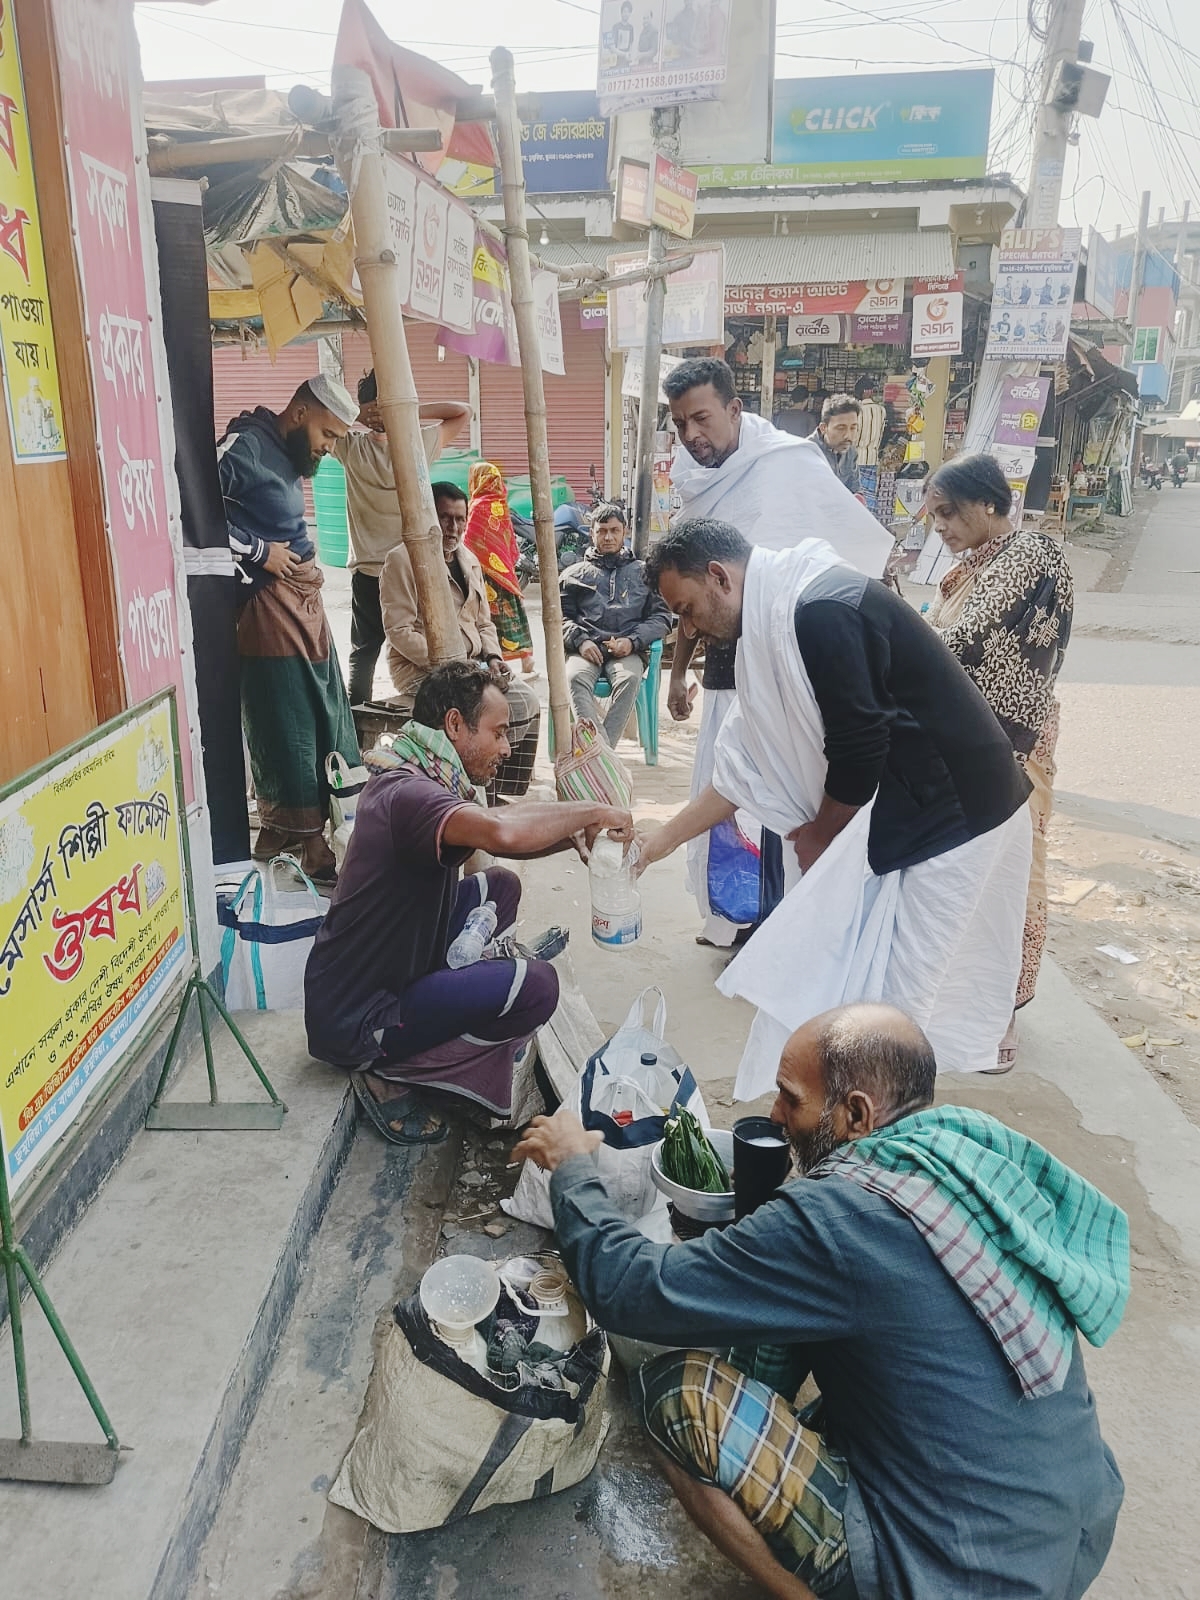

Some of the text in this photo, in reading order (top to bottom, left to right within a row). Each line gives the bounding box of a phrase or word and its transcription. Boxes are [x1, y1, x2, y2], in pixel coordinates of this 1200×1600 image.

[805, 105, 880, 131] CLICK
[79, 151, 131, 257] সকল
[1000, 251, 1057, 260] SPECIAL BATCH
[1001, 230, 1060, 251] ALIF'S
[1, 293, 45, 326] পাওয়া
[755, 300, 804, 315] নগদ-এ
[869, 297, 898, 308] নগদ
[100, 304, 146, 401] প্রকার
[795, 325, 830, 337] রকেট
[921, 322, 954, 336] নগদ
[117, 424, 159, 537] ঔষধ
[128, 582, 176, 673] পাওয়া
[58, 802, 109, 879] শিল্পী
[115, 791, 170, 840] ফার্মেসী
[43, 863, 143, 981] ঔষধ
[6, 1045, 36, 1089] এখানে
[38, 1018, 63, 1049] সকল
[65, 990, 88, 1023] প্রকার
[89, 965, 109, 999] দেশী
[110, 937, 136, 974] বিদেশী
[48, 1050, 57, 1064] ও
[80, 995, 103, 1026] পাখির
